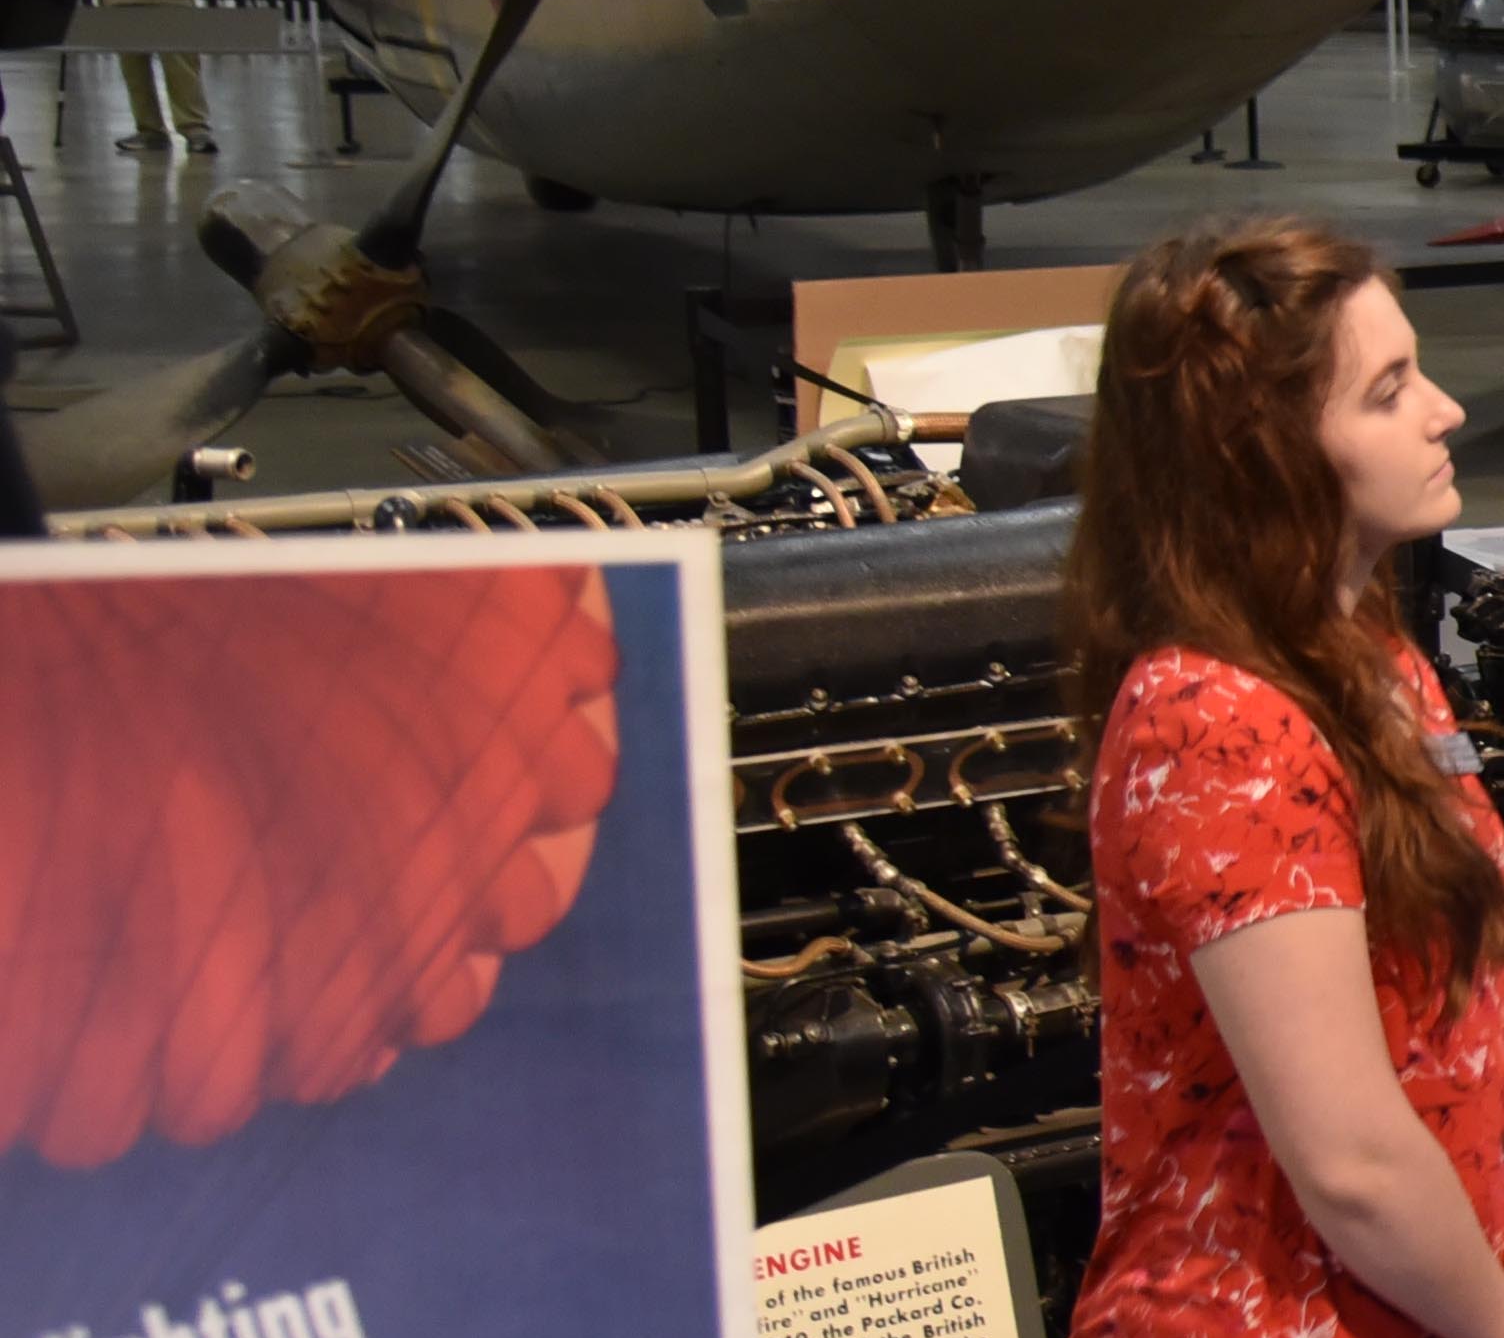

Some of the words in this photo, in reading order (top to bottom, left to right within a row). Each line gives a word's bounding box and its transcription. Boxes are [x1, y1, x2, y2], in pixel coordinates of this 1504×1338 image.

[753, 1236, 863, 1281] ENGINE
[765, 1289, 785, 1311] of
[793, 1284, 826, 1304] the
[832, 1266, 907, 1295] famous
[911, 1248, 976, 1277] British
[810, 1298, 850, 1324] and
[861, 1298, 944, 1334] Packard
[950, 1292, 983, 1314] Co.
